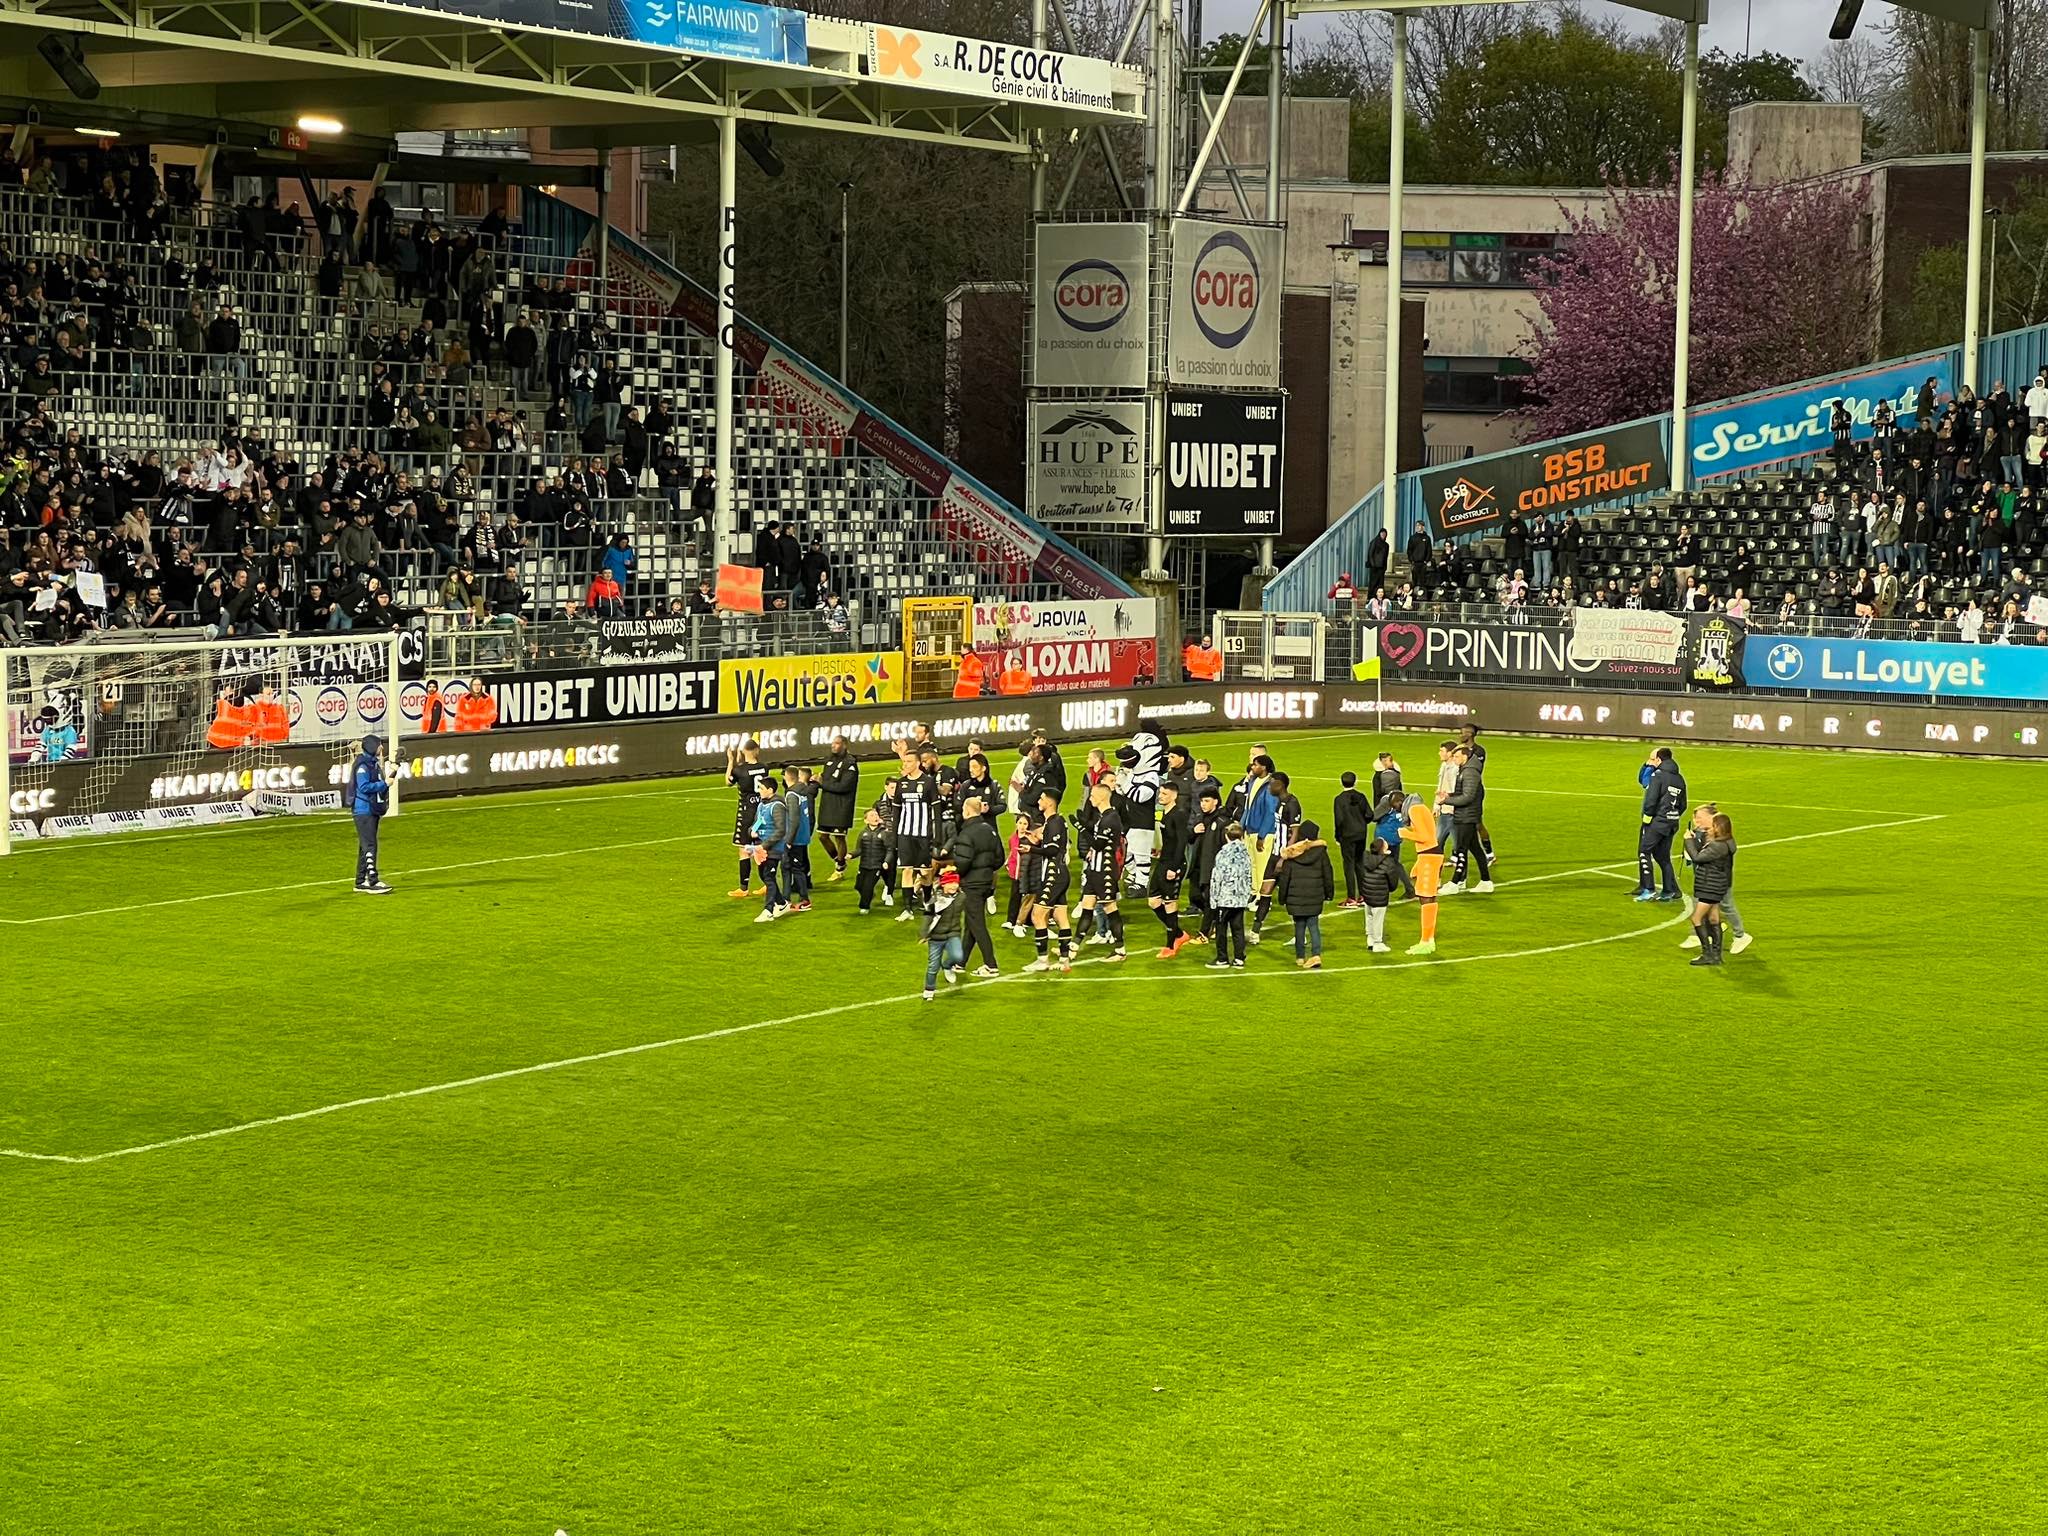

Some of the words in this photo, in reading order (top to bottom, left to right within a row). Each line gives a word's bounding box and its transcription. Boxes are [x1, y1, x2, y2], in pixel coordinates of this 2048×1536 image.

[677, 1, 759, 33] FAIRWIND
[934, 53, 951, 68] S.A.
[954, 41, 972, 71] R.
[979, 45, 1005, 76] DE
[1010, 50, 1064, 85] COCK
[992, 77, 1024, 96] Génie
[1027, 83, 1048, 99] civil
[1051, 88, 1059, 101] &
[1062, 88, 1112, 109] bâtiments
[1058, 284, 1124, 307] cora
[1195, 269, 1254, 308] cora
[1039, 338, 1048, 348] la
[1050, 339, 1094, 350] passion
[1097, 338, 1111, 349] du
[1113, 338, 1144, 350] choix
[1175, 356, 1185, 373] la
[1188, 357, 1229, 376] passion
[1229, 360, 1243, 376] du
[1245, 360, 1272, 377] choix
[772, 358, 823, 396] Mondial
[1171, 402, 1203, 417] UNIBET
[1245, 406, 1277, 419] UNIBET
[1040, 437, 1139, 464] HUPÉ
[1170, 442, 1276, 488] UNIBET
[1543, 443, 1606, 482] BSB
[1043, 468, 1093, 478] ASSURANCES
[1101, 468, 1136, 478] FLEURUS
[1060, 480, 1117, 497] www.hupe.be
[1443, 484, 1468, 501] BSB
[1519, 462, 1652, 511] CONSTRUCT
[953, 484, 1008, 525] Mondial
[1078, 503, 1104, 515] aussi
[1169, 510, 1202, 524] UNIBET
[1244, 510, 1275, 524] UNIBET
[1449, 507, 1489, 522] CONSTRUCT
[602, 620, 648, 640] GUEULES
[649, 618, 686, 637] NOIRES
[916, 641, 926, 655] 20
[1227, 637, 1243, 652] 19
[813, 657, 857, 676] plastics
[1026, 642, 1111, 677] LOXAM
[1608, 662, 1665, 674] Suivez-nous
[1667, 666, 1682, 675] sur
[1822, 649, 1985, 690] L.Louyet
[330, 674, 355, 686] 2013
[1044, 682, 1056, 691] bien
[1056, 681, 1068, 691] plus
[1069, 681, 1079, 690] que
[1080, 680, 1087, 689] du
[1088, 678, 1110, 688] matériel
[105, 683, 121, 699] 21
[606, 671, 716, 717] UNIBET
[735, 668, 857, 713] Wauters
[317, 700, 347, 714] cora
[358, 696, 386, 710] cora
[1224, 692, 1319, 720] UNIBET
[1339, 698, 1375, 713] Jouez
[1376, 701, 1403, 713] avec
[1403, 698, 1468, 715] modération
[1061, 699, 1128, 731] UNIBET
[810, 720, 919, 746] #KAPPA4RCSC
[934, 713, 1030, 738] #KAPPA4RCSC
[686, 728, 798, 756] #KAPPA4RCSC
[489, 743, 621, 773] #KAPPA4RCSC
[150, 765, 306, 799] #KAPPA4RCSC
[209, 803, 244, 815] UNIBET
[262, 792, 293, 808] UNIBET
[304, 793, 336, 807] UNIBET
[54, 815, 94, 829] UNIBET
[108, 810, 147, 824] UNIBET
[158, 806, 197, 819] UNIBET
